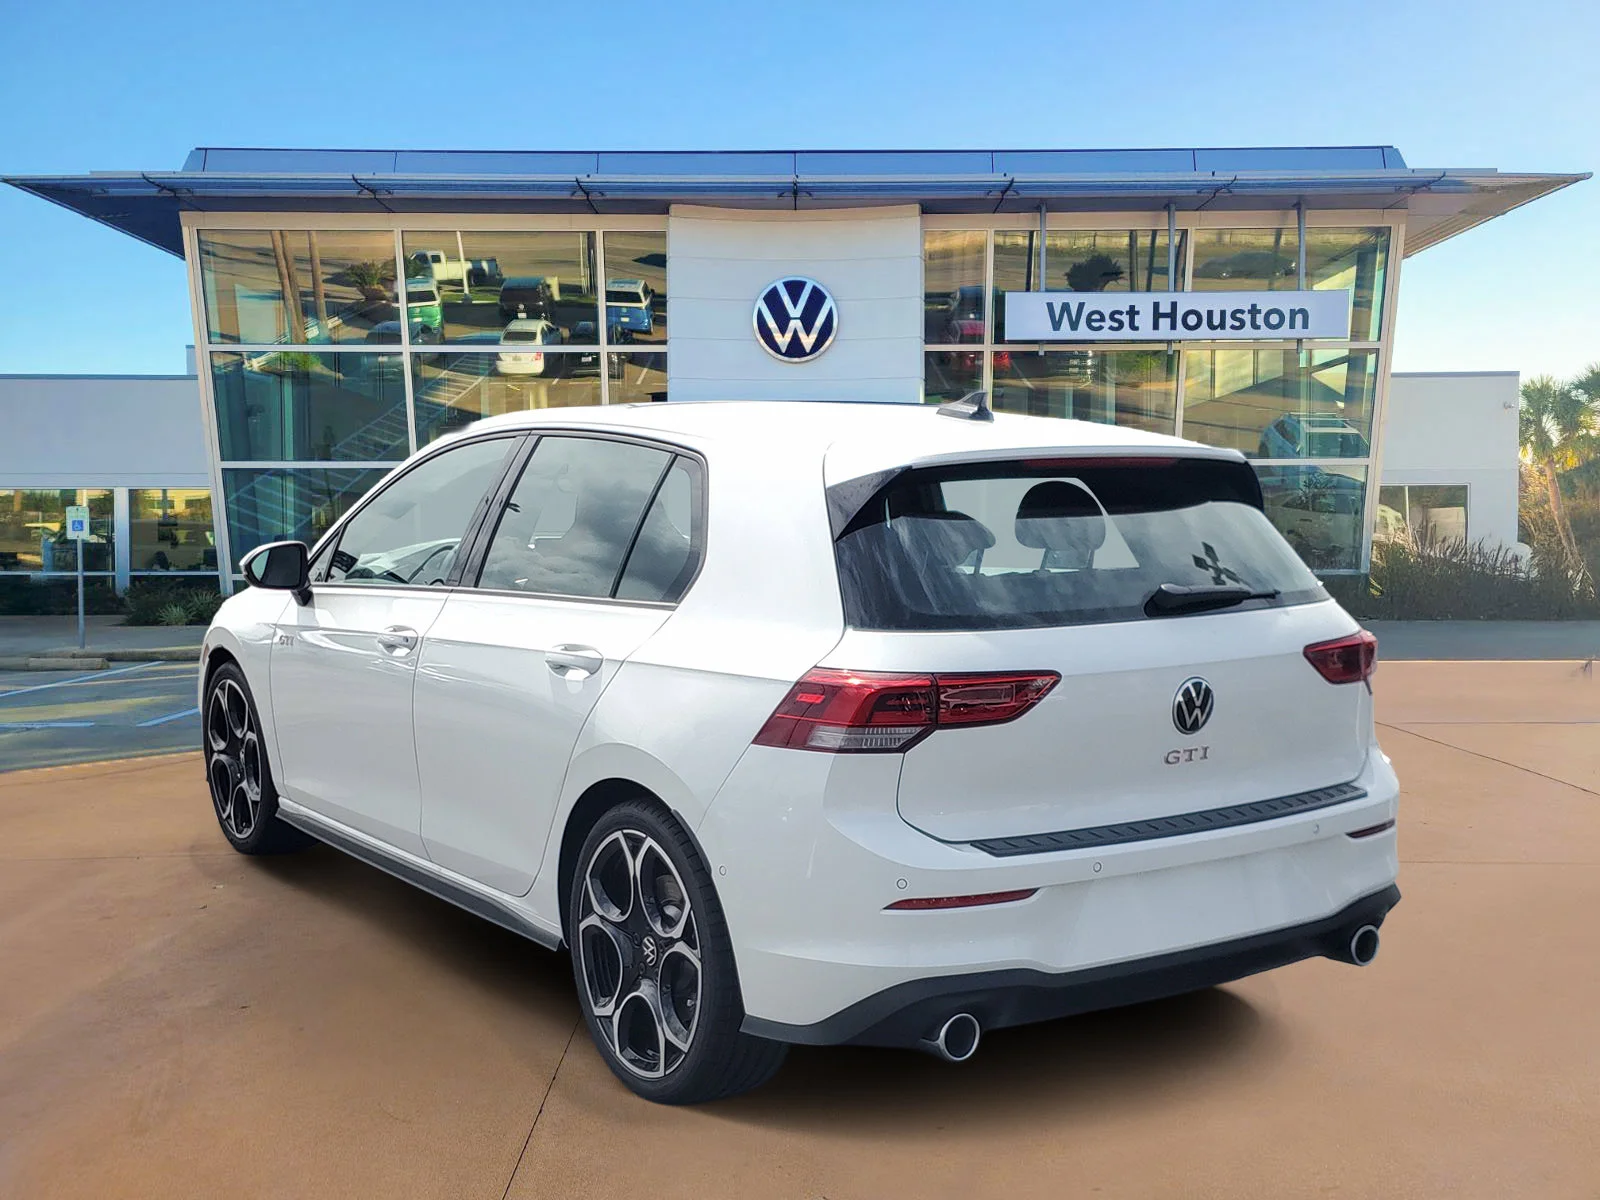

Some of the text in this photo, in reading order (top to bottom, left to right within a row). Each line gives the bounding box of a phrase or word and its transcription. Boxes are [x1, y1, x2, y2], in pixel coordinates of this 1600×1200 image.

[755, 278, 836, 358] VW
[1046, 300, 1310, 331] West Houston
[1163, 745, 1210, 765] GTI
